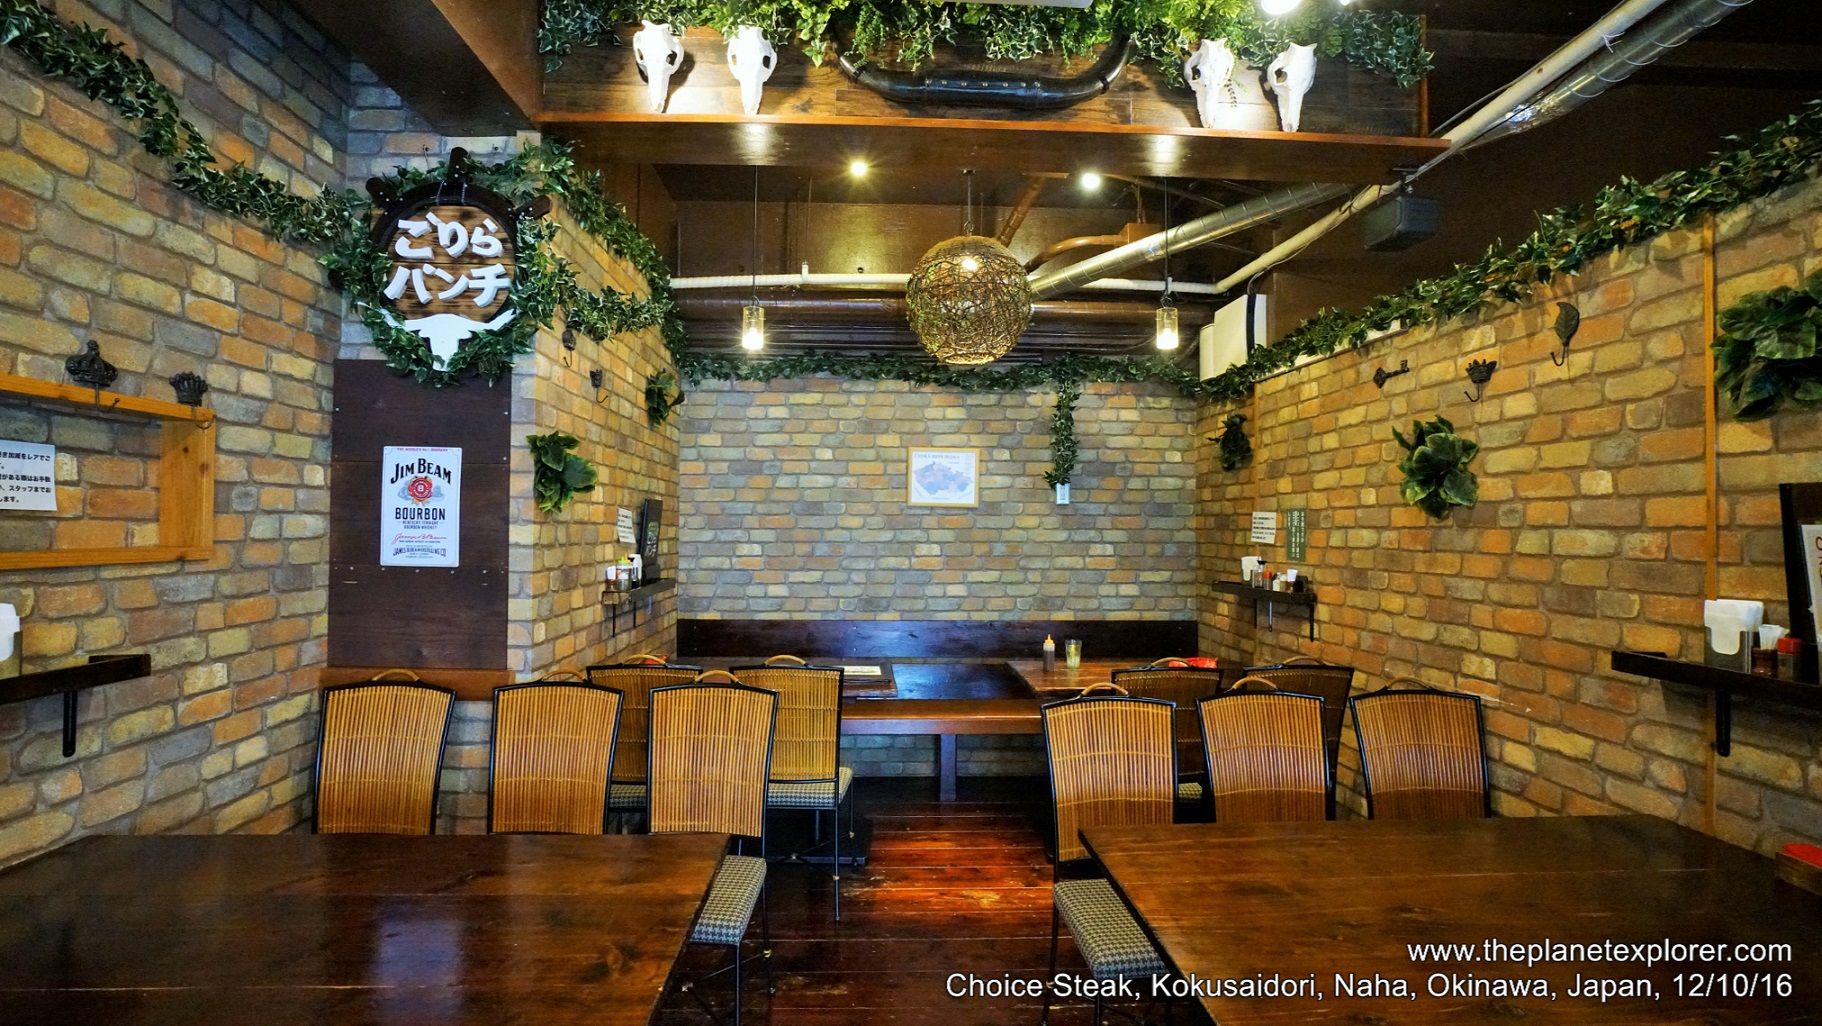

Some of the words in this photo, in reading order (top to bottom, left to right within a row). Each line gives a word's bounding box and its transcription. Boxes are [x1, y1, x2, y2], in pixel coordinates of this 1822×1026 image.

[390, 462, 415, 484] JIM
[417, 458, 451, 485] BEAM
[0, 484, 51, 493] 、スタッフまでお
[395, 507, 446, 520] BOURBON
